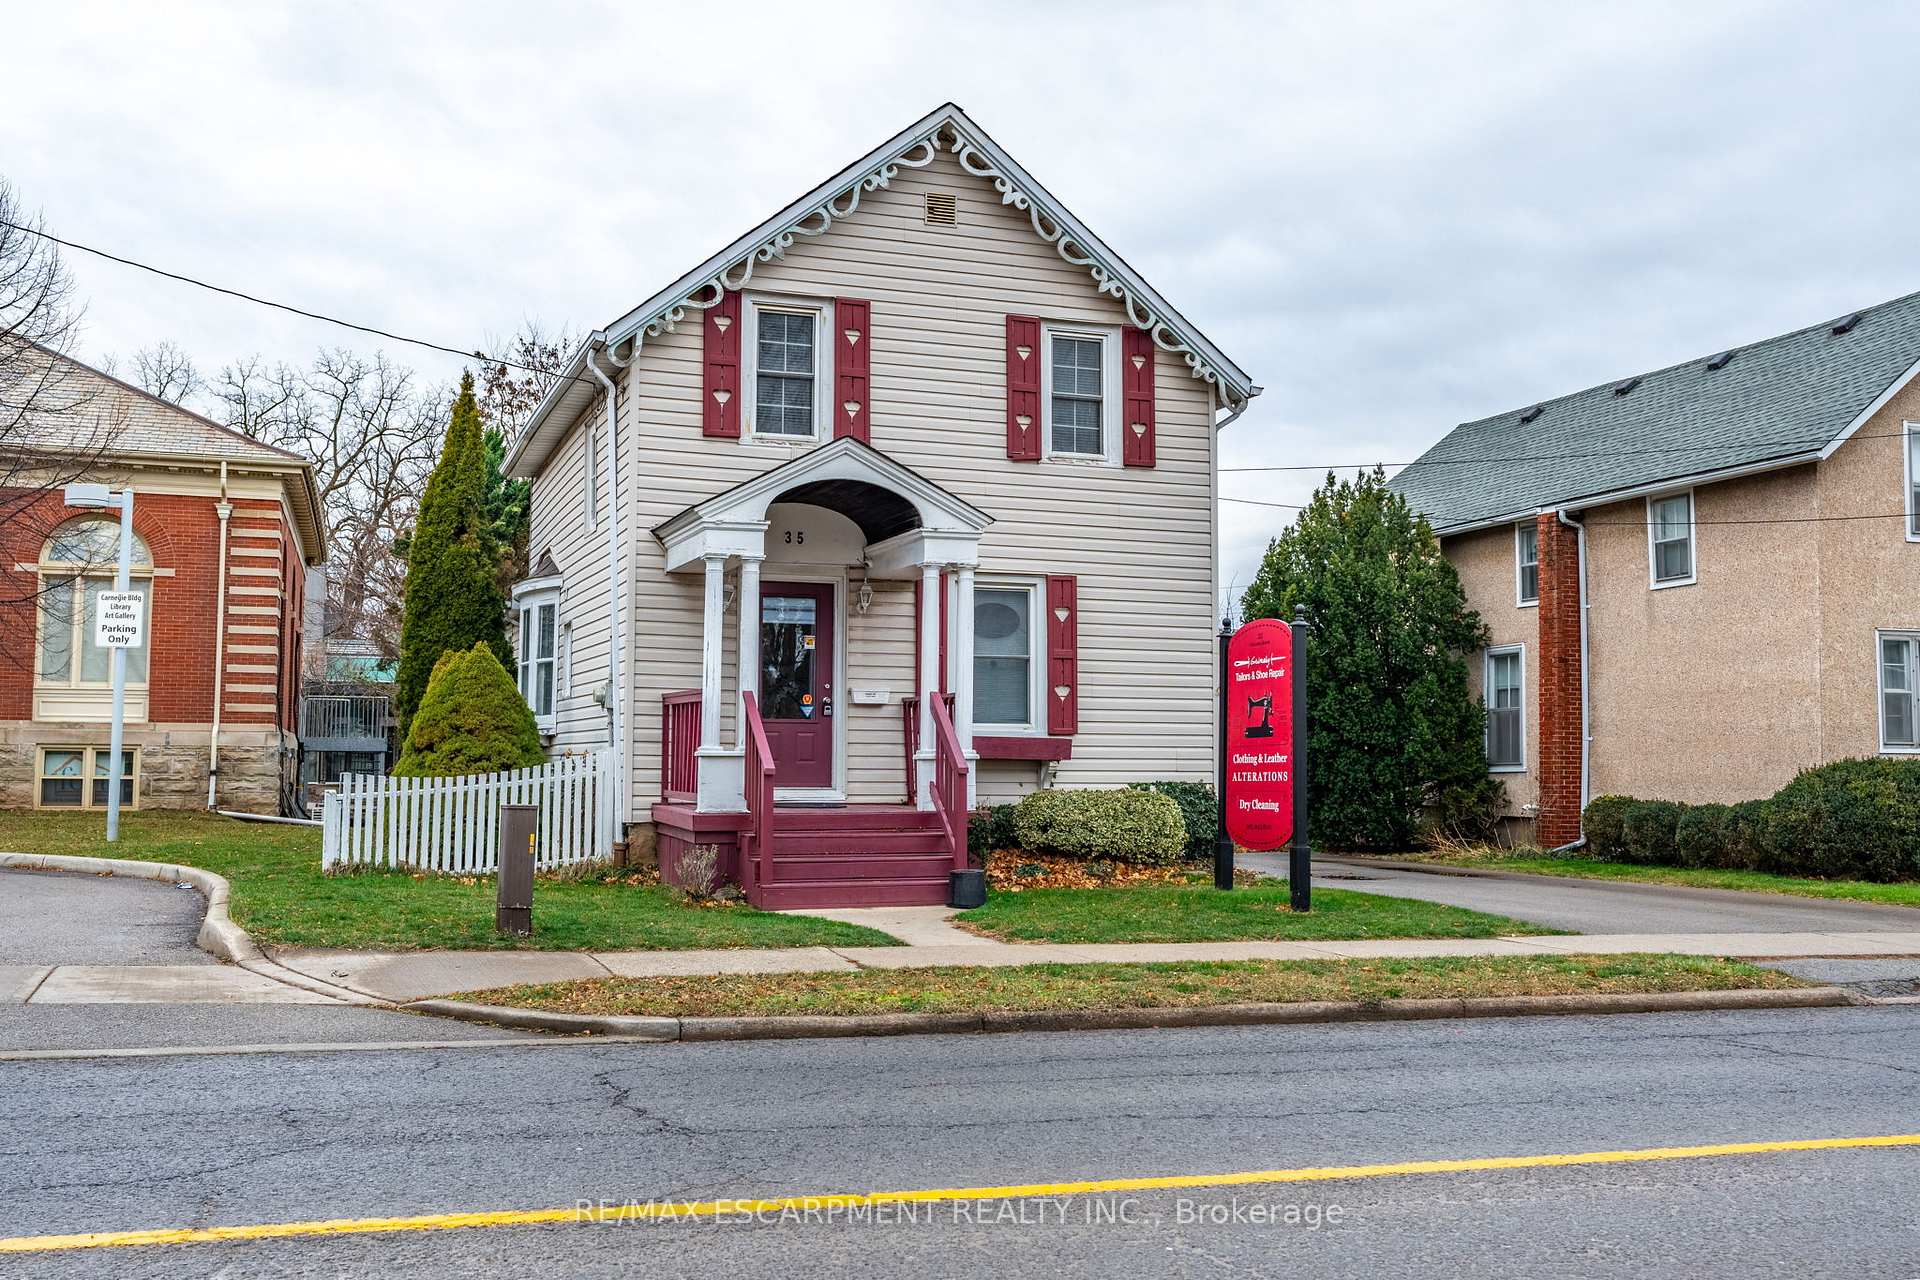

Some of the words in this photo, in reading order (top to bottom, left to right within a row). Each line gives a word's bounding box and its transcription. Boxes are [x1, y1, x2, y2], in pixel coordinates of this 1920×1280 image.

[785, 530, 804, 545] 35
[101, 594, 127, 602] Carnegie
[128, 594, 142, 602] Bldg
[110, 603, 131, 611] Library
[115, 612, 136, 620] Gallery
[102, 625, 136, 634] Parking
[108, 635, 130, 644] Only
[1256, 670, 1268, 679] Shoe
[1269, 668, 1285, 679] Repair
[1233, 753, 1258, 766] Clothing
[1258, 753, 1263, 764] &
[1264, 752, 1288, 763] Leather
[1232, 771, 1288, 782] ALTERATIONS
[1239, 799, 1251, 812] Dry
[1252, 798, 1280, 812] Cleaning
